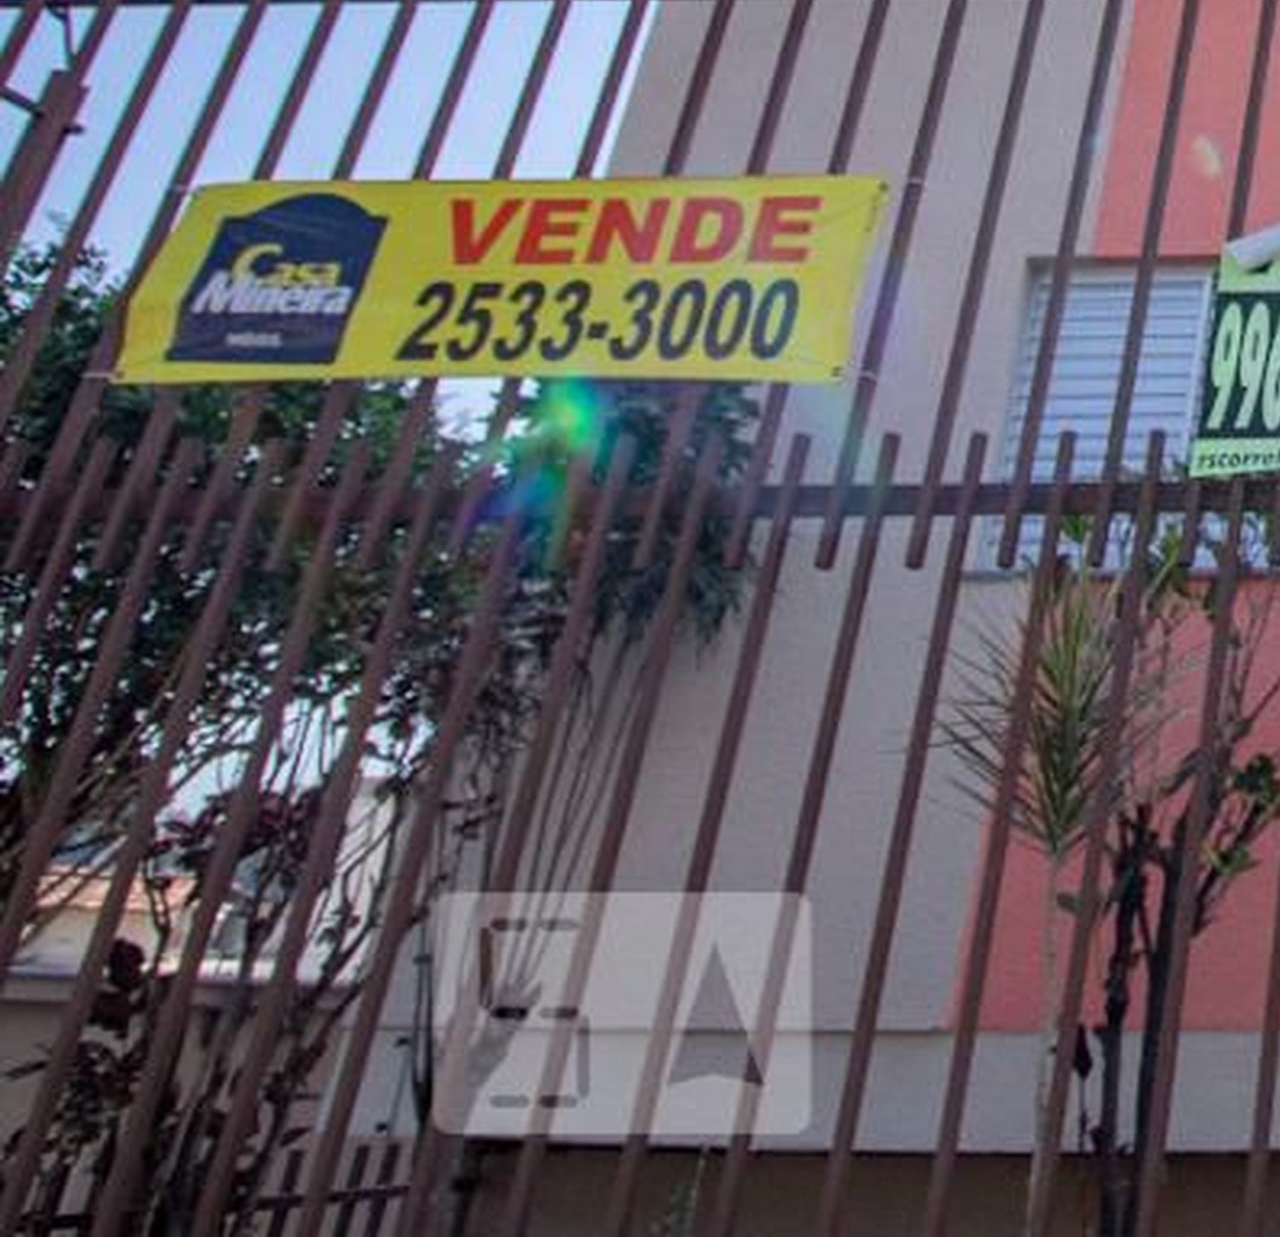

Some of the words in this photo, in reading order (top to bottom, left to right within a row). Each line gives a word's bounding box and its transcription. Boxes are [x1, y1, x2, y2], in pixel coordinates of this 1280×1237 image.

[449, 196, 823, 264] VENDE
[190, 270, 354, 314] Mineira
[231, 243, 342, 288] Casa
[397, 278, 800, 361] 2533-3000
